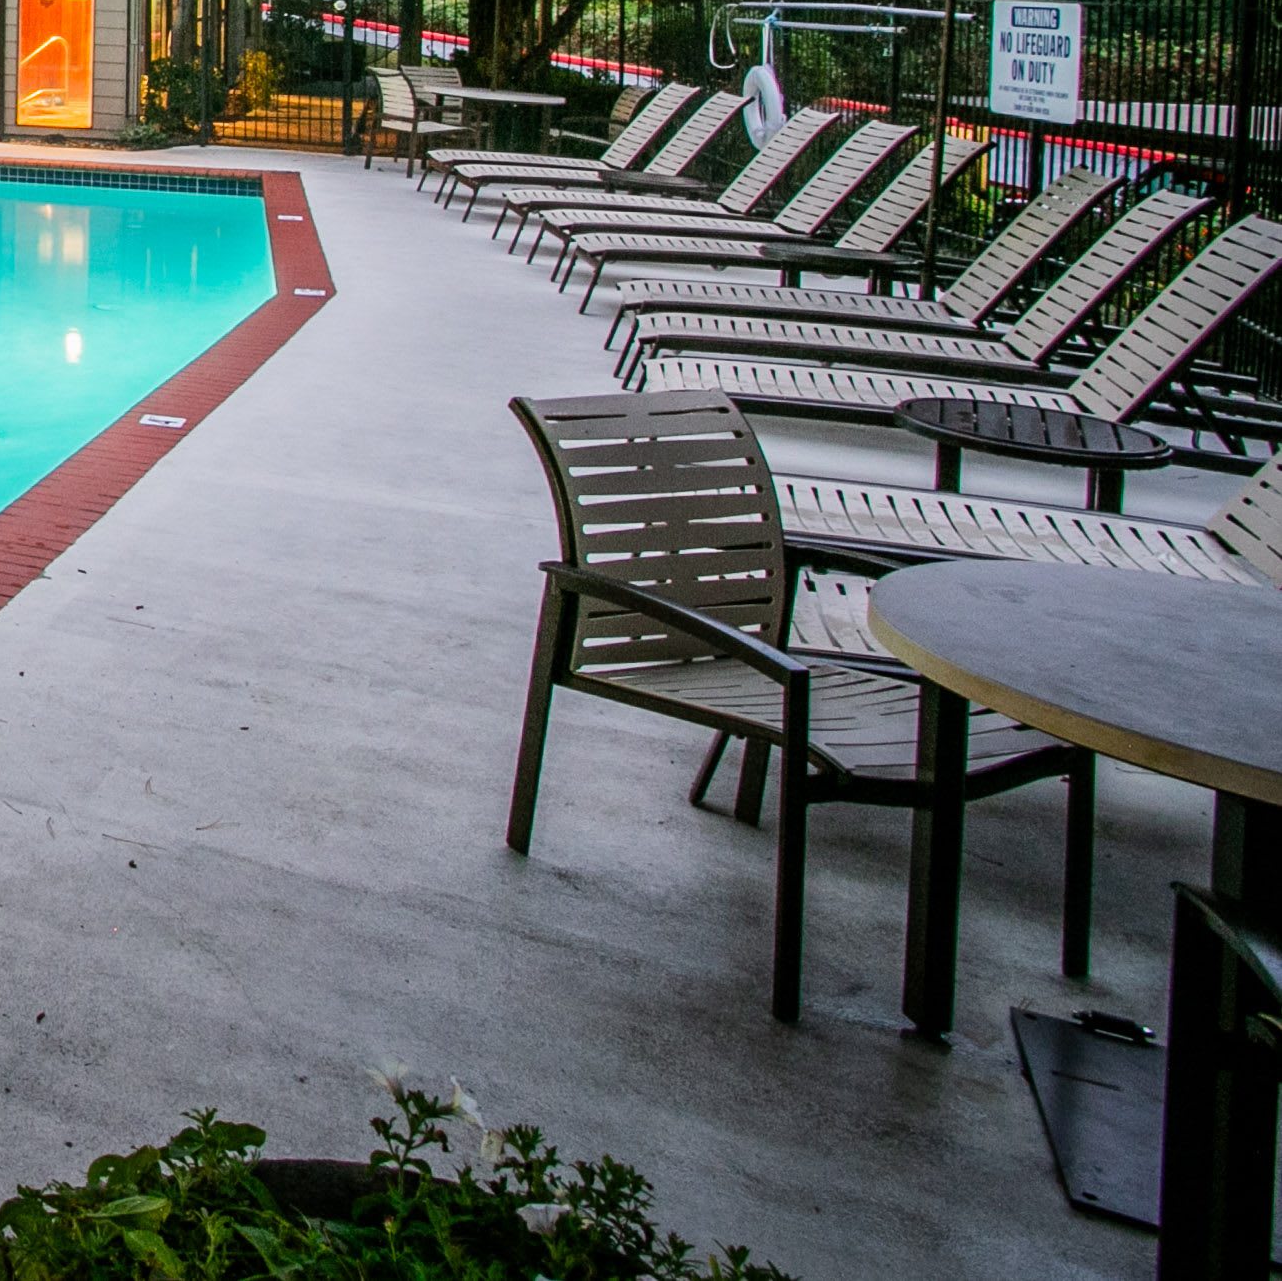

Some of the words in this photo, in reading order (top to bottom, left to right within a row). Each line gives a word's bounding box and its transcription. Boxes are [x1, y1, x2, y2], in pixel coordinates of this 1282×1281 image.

[1014, 7, 1058, 29] WARNING
[999, 31, 1013, 53] NO
[1016, 32, 1071, 59] LIFEGUARD
[1011, 59, 1025, 81] ON
[1028, 61, 1055, 85] DUTY
